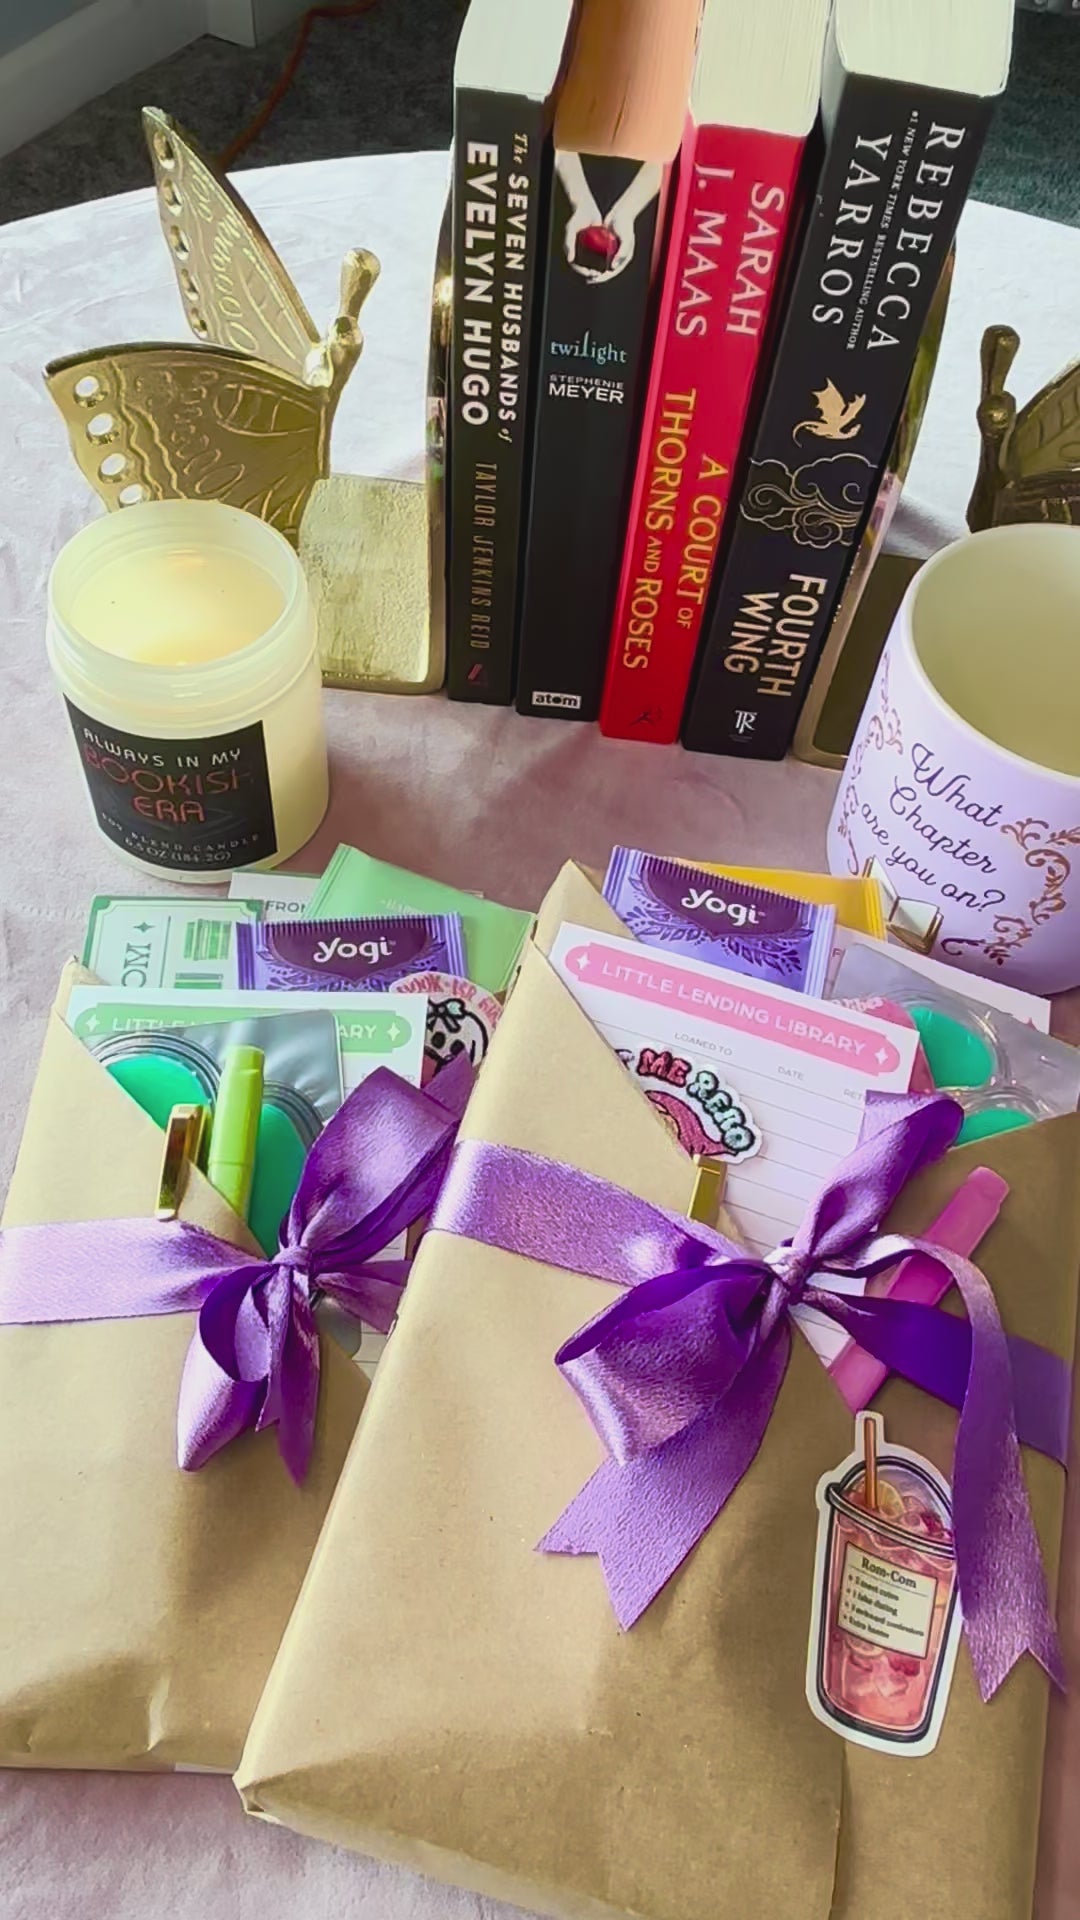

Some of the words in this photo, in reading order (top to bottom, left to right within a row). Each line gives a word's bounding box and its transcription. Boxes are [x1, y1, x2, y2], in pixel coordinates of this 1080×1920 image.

[513, 133, 529, 164] The
[902, 127, 916, 156] NEW
[694, 163, 735, 190] J.
[891, 160, 907, 191] YORK
[463, 141, 499, 304] EVELYN
[505, 173, 530, 271] SEVEN
[812, 133, 893, 325] YARROS
[880, 194, 898, 229] TIMES
[866, 121, 966, 350] REBECCA
[675, 208, 727, 337] MAAS
[726, 182, 785, 337] SARAH
[859, 234, 887, 305] BESTSELLING
[550, 330, 628, 365] twilight
[846, 307, 865, 350] AUTHOR
[462, 318, 492, 426] HUGO
[498, 282, 523, 421] HUSBANDS
[549, 373, 624, 390] STEPHENIE
[549, 382, 625, 404] MEYER
[498, 428, 512, 443] of
[645, 388, 697, 532] THORNS
[698, 453, 729, 480] A
[473, 463, 498, 527] TAYLOR
[642, 535, 662, 573] AND
[676, 494, 722, 604] COURT
[471, 535, 494, 607] JENKINS
[470, 613, 491, 649] REID
[623, 577, 663, 669] ROSES
[676, 607, 694, 629] OF
[723, 591, 781, 675] WING
[757, 573, 829, 697] FOURTH
[535, 694, 578, 707] atom
[83, 727, 165, 767] ALWAYS
[176, 756, 199, 768] IN
[212, 748, 240, 766] MY
[911, 742, 1003, 827] What
[132, 796, 206, 823] ERA
[890, 775, 998, 874] Chapter
[861, 803, 890, 846] are
[885, 845, 937, 886] you
[941, 883, 1006, 913] on?
[681, 888, 760, 926] yogi
[313, 936, 393, 964] yogi
[602, 960, 673, 993] LITTLE
[677, 983, 770, 1024] LENDING
[775, 1015, 866, 1055] LIBRARY
[674, 1032, 717, 1051] LOANED
[718, 1045, 733, 1056] TO
[636, 1047, 692, 1088] ME
[778, 1065, 805, 1081] DATE
[861, 1556, 917, 1588] Rom-Com
